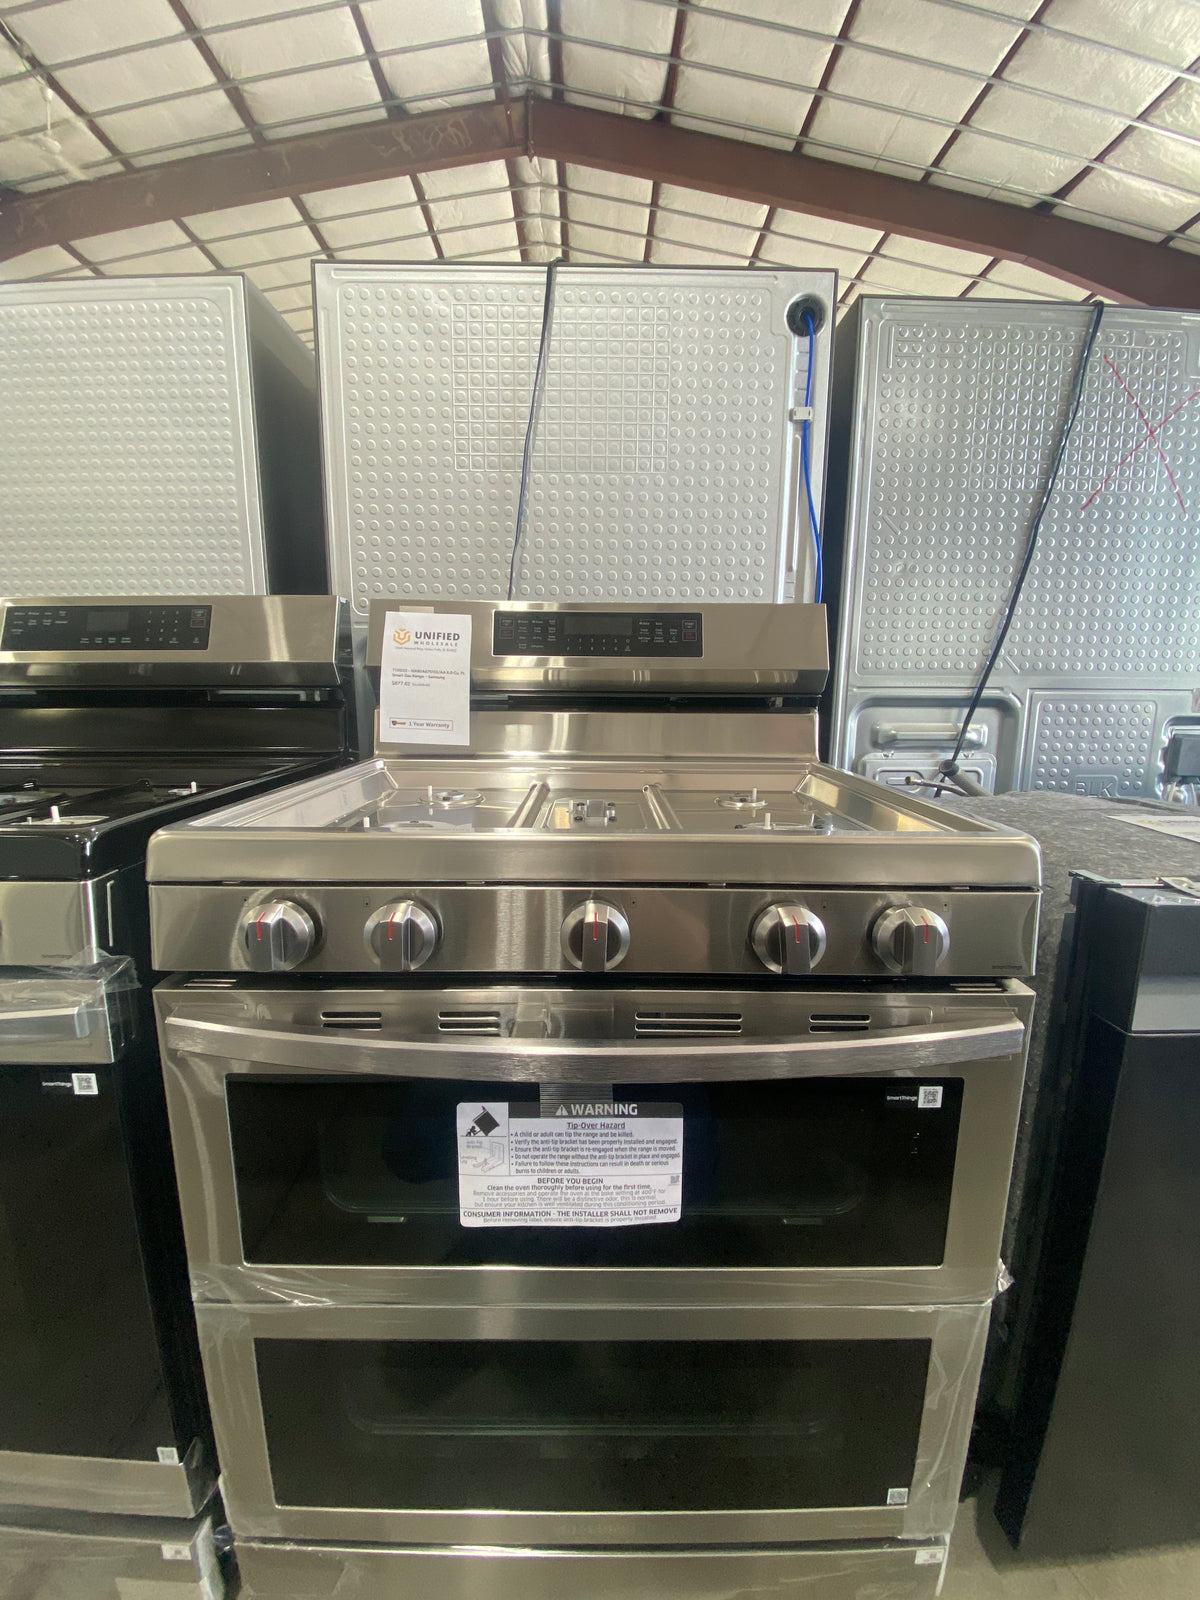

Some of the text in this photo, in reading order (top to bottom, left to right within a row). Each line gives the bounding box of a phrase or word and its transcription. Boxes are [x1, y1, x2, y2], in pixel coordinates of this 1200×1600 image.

[415, 632, 460, 640] UNIFIED
[1075, 782, 1114, 798] BLK
[571, 1103, 638, 1115] WARNING
